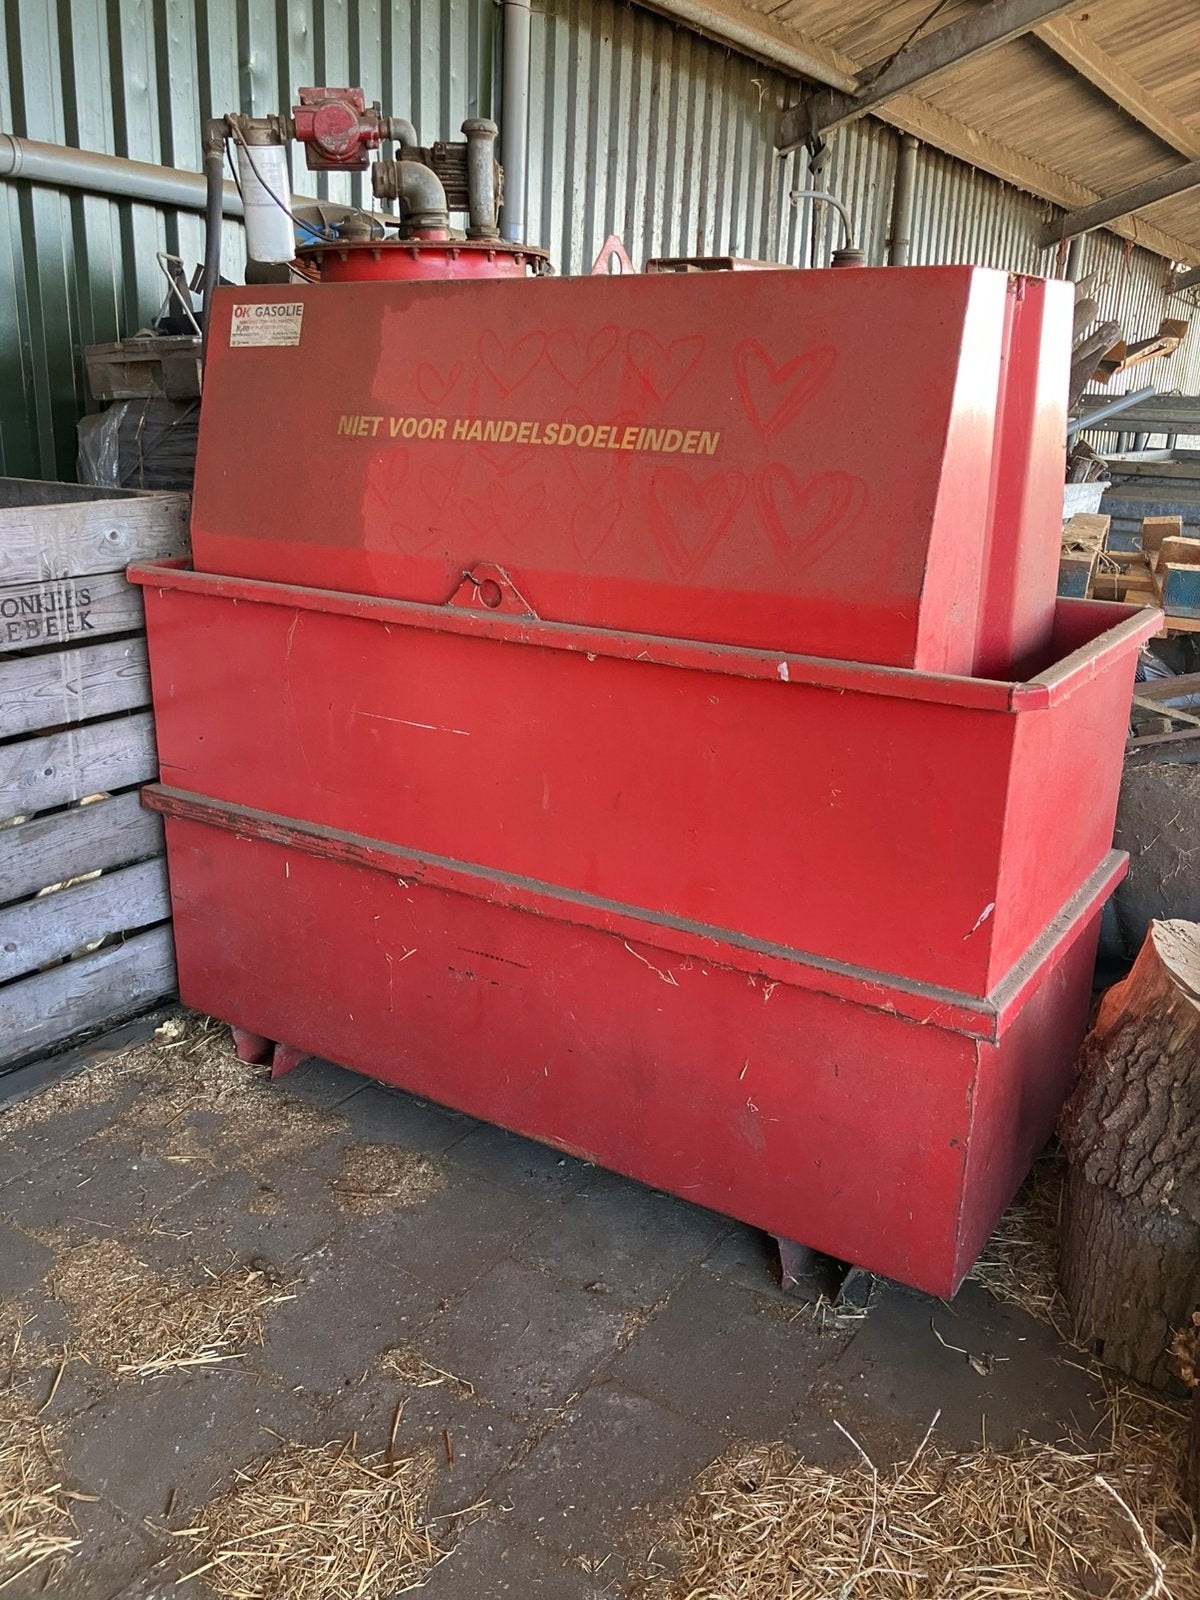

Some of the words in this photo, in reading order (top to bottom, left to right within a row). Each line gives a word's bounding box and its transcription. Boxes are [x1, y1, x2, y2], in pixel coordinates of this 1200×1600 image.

[234, 306, 251, 318] OK
[255, 304, 303, 318] GASOLIE
[337, 415, 383, 437] NIET
[389, 417, 448, 440] VOOR
[451, 419, 720, 455] HANDELSDOELEINDEN
[0, 610, 96, 642] EBEEK
